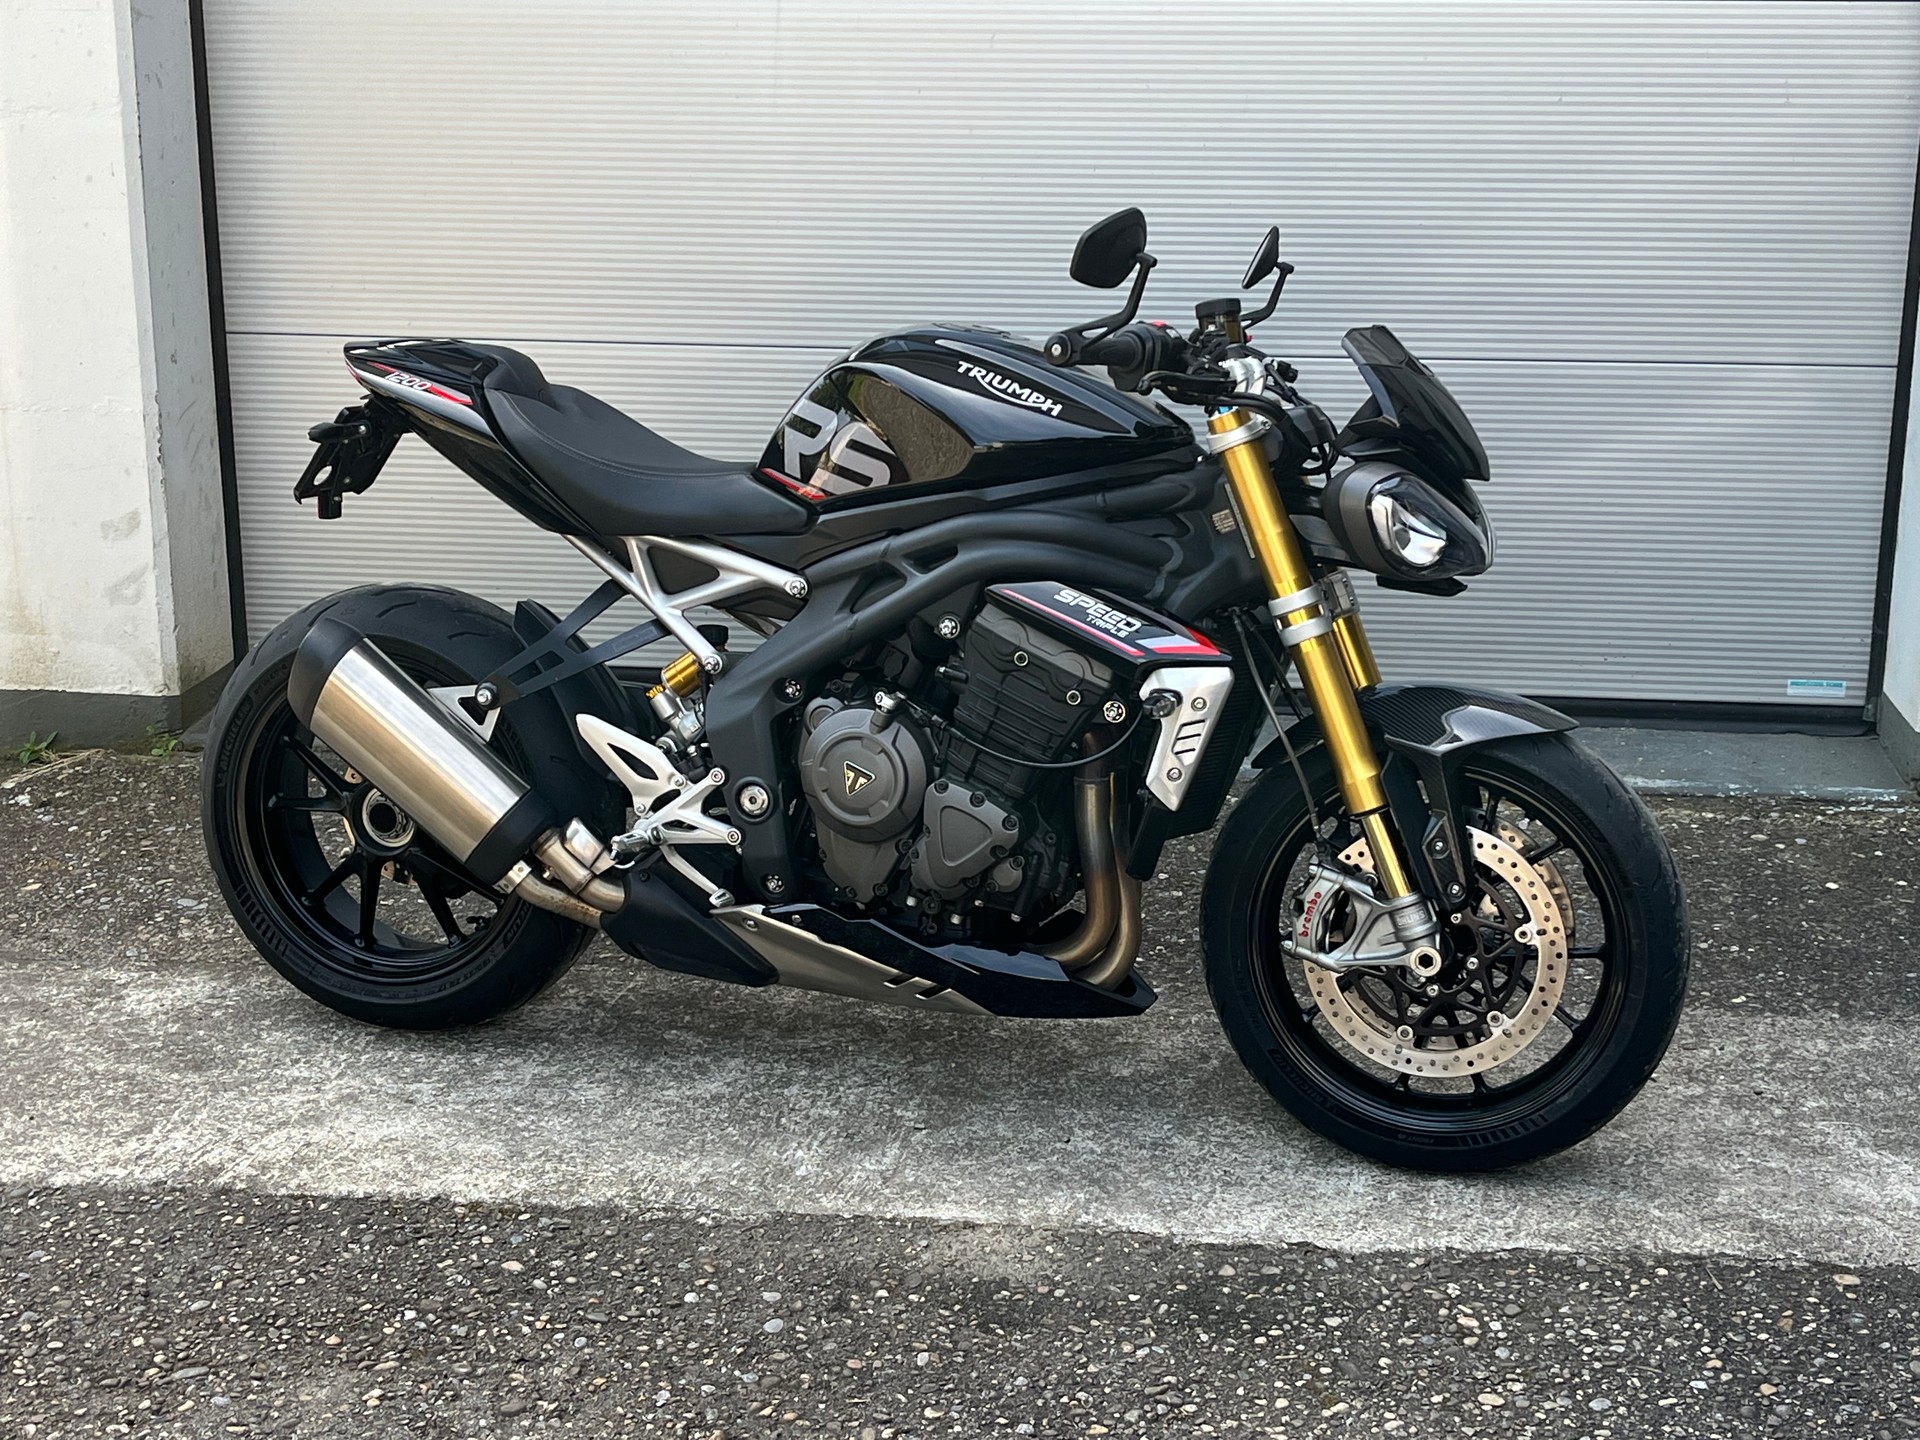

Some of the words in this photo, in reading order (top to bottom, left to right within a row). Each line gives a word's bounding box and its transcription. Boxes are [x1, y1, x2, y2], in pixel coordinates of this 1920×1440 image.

[384, 371, 432, 390] 1200
[957, 361, 1062, 416] TRIUMPH
[783, 398, 895, 495] RS
[1053, 589, 1142, 632] SPEED
[1086, 616, 1130, 639] TRIPLE
[1298, 891, 1322, 938] brembo
